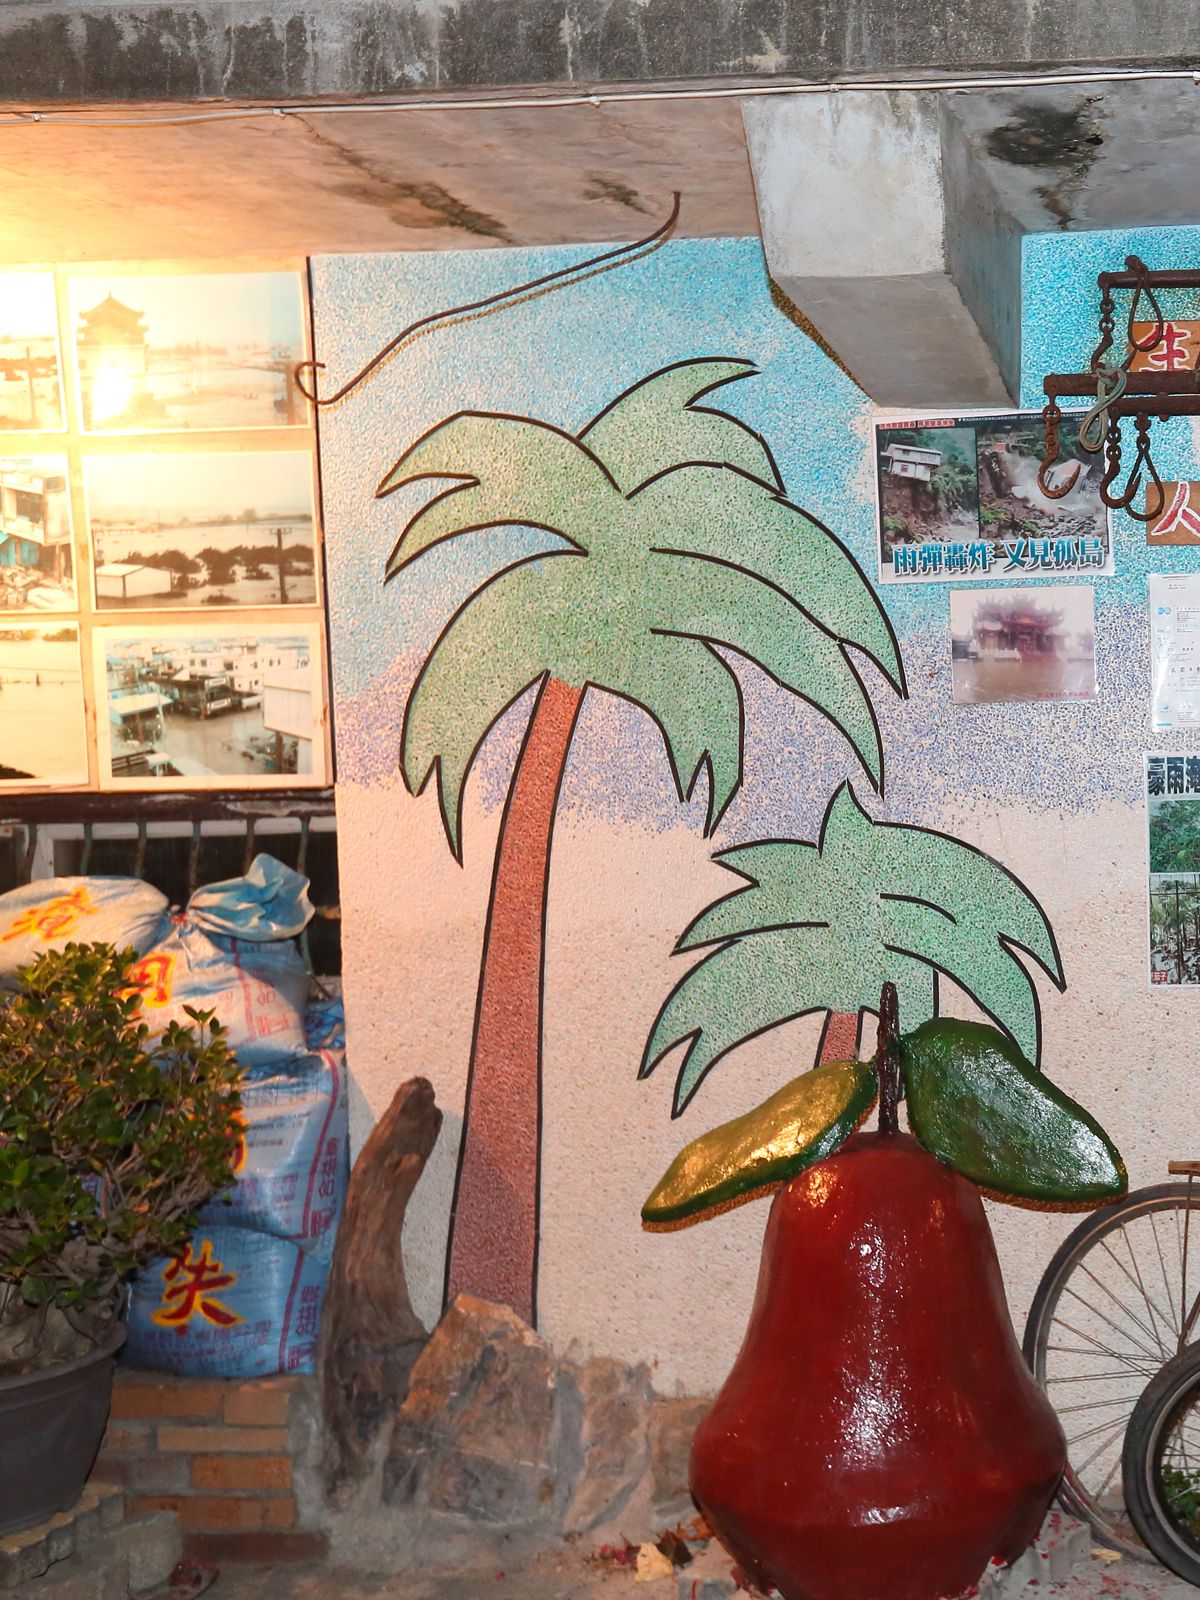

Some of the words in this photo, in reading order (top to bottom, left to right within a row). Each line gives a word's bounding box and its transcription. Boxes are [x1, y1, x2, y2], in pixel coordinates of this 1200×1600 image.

[893, 541, 996, 576] 雨彈轟炸
[1000, 535, 1104, 572] 又見孤島
